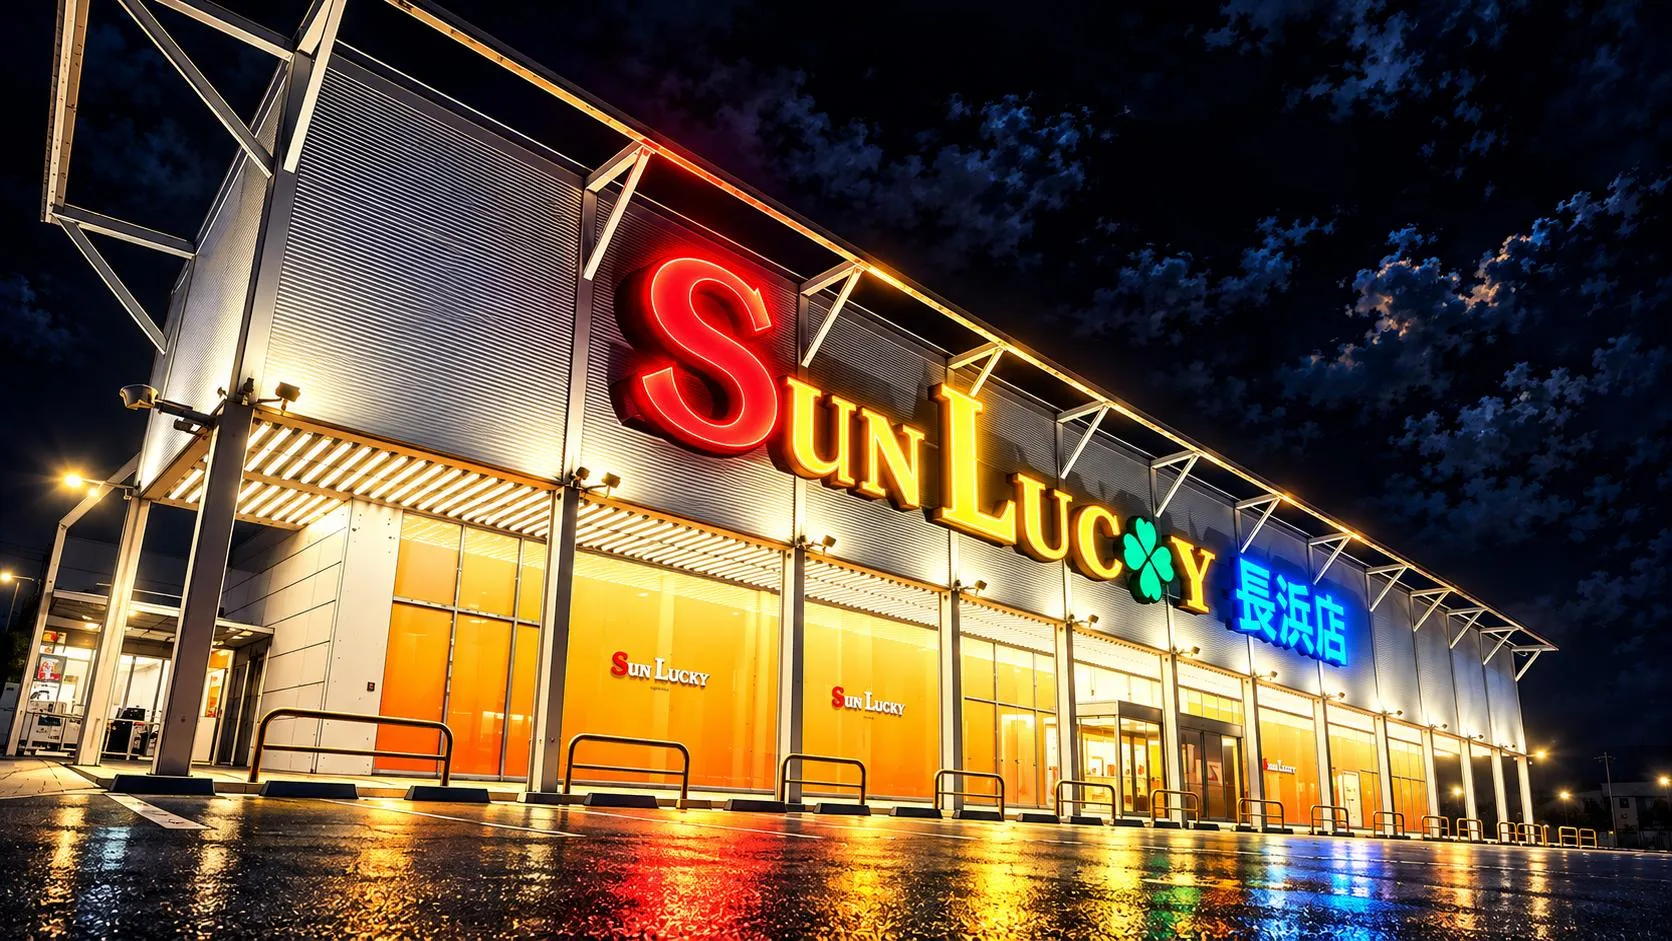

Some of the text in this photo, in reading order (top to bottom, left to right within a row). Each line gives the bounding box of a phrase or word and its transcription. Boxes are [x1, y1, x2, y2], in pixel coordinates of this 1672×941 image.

[936, 383, 1216, 614] LUCY
[1236, 557, 1348, 667] 長浜店
